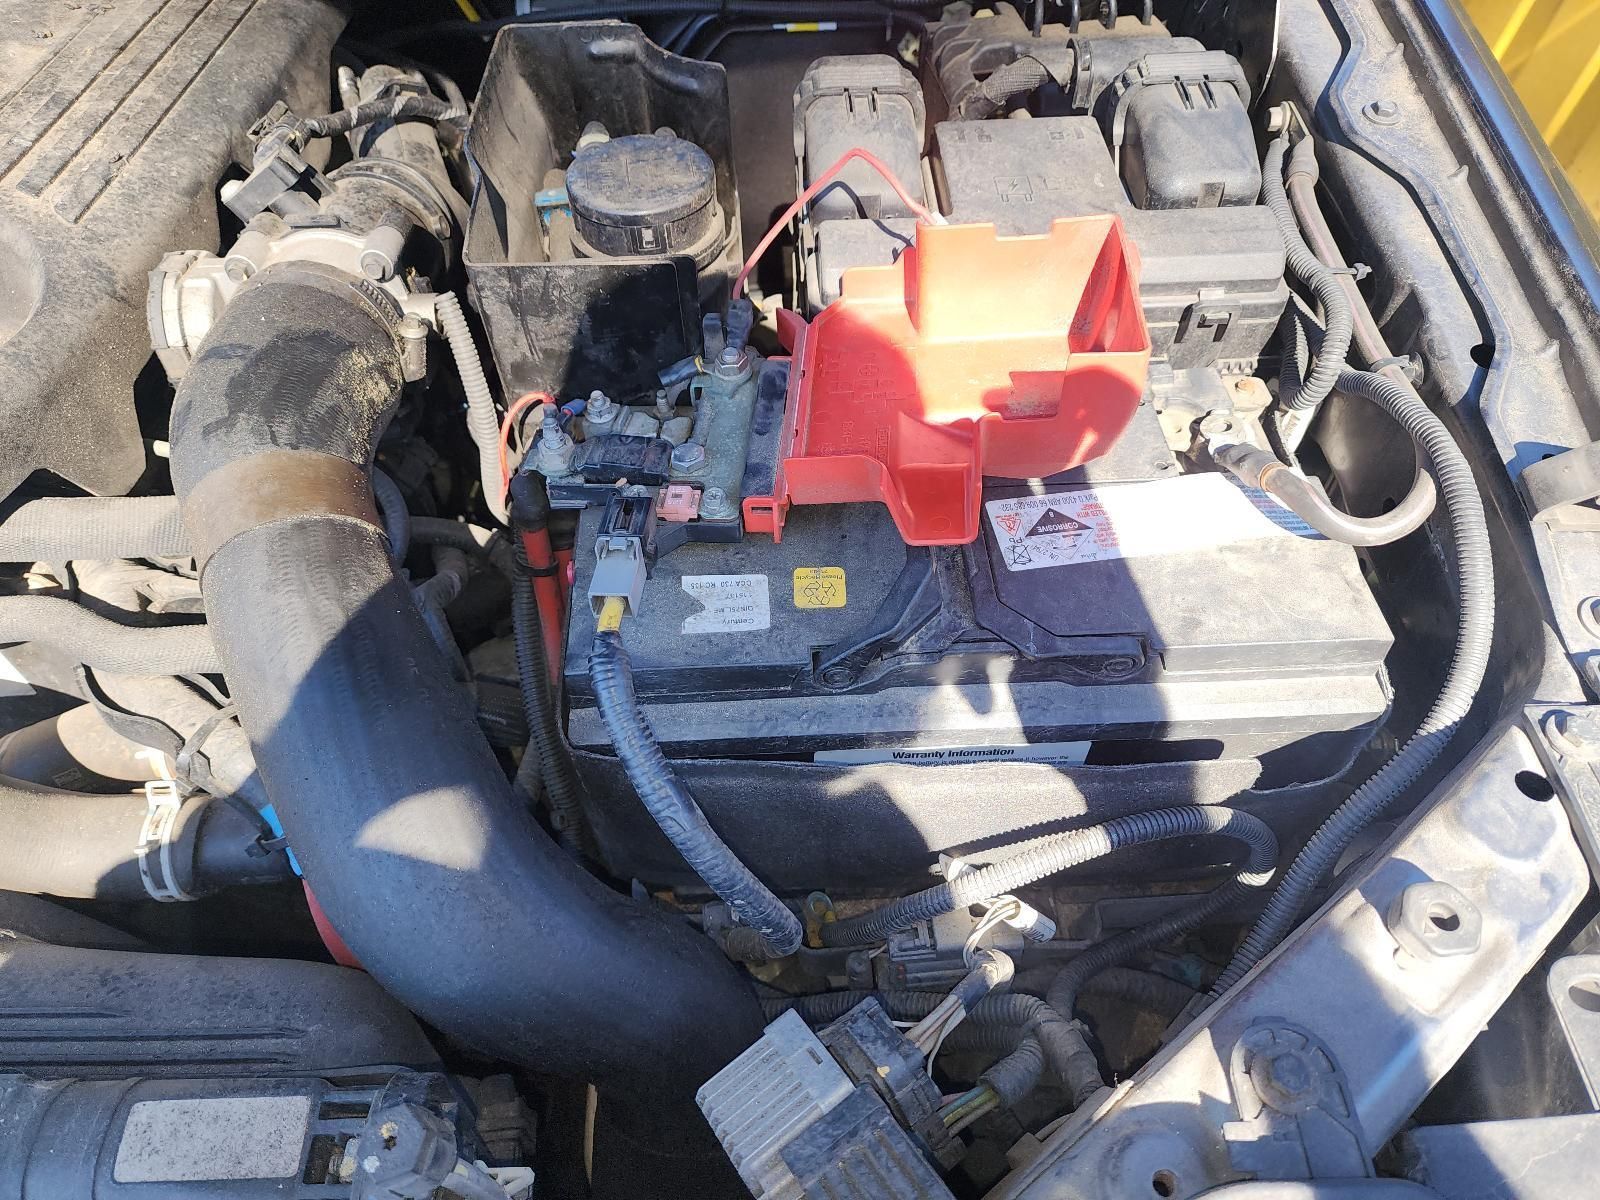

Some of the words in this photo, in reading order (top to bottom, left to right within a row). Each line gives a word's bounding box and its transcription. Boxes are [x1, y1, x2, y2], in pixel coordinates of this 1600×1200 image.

[1036, 522, 1079, 533] CORROSIVE
[705, 581, 716, 589] RC
[892, 750, 945, 759] Warranty
[948, 748, 1015, 757] Information
